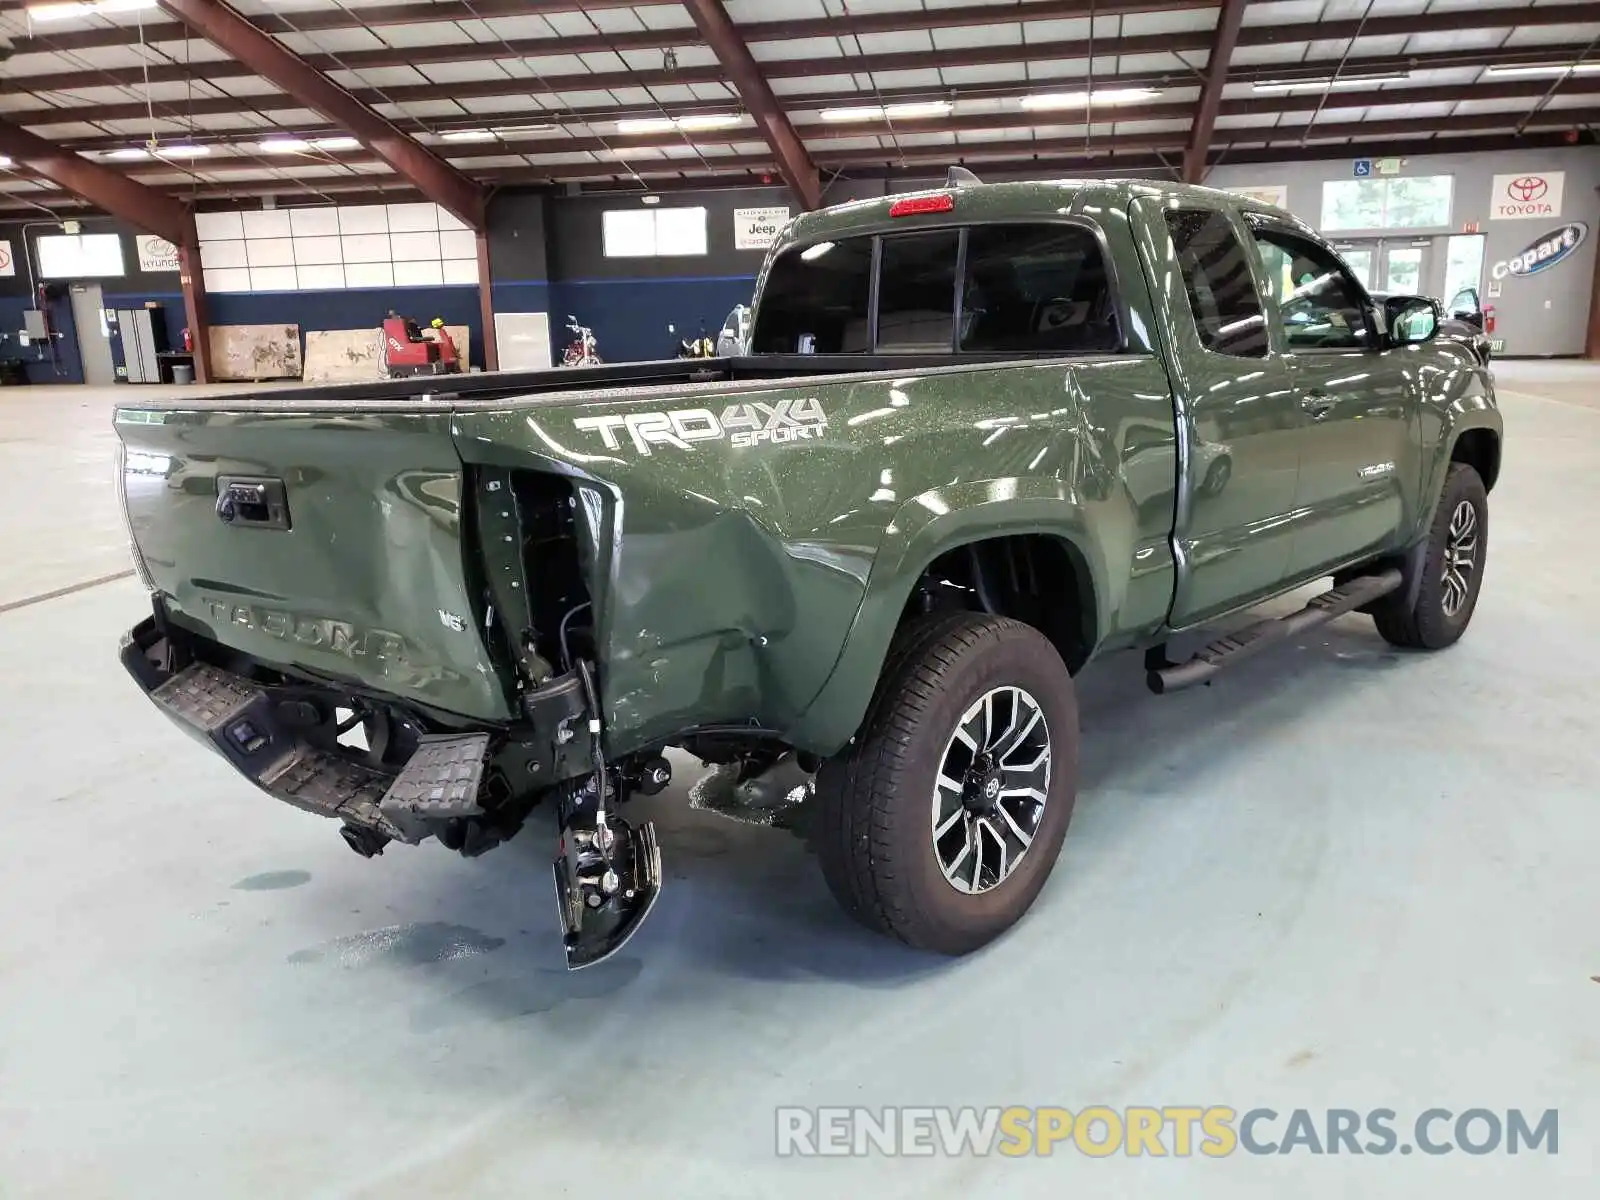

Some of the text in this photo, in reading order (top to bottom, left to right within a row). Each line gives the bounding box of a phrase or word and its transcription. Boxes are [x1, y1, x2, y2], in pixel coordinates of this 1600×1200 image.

[1498, 203, 1552, 216] TOYOTA
[748, 223, 777, 236] Jeep
[1492, 223, 1576, 280] Copart
[142, 259, 181, 268] HYUNDA
[573, 409, 726, 457] TRD
[730, 423, 829, 448] SPORT
